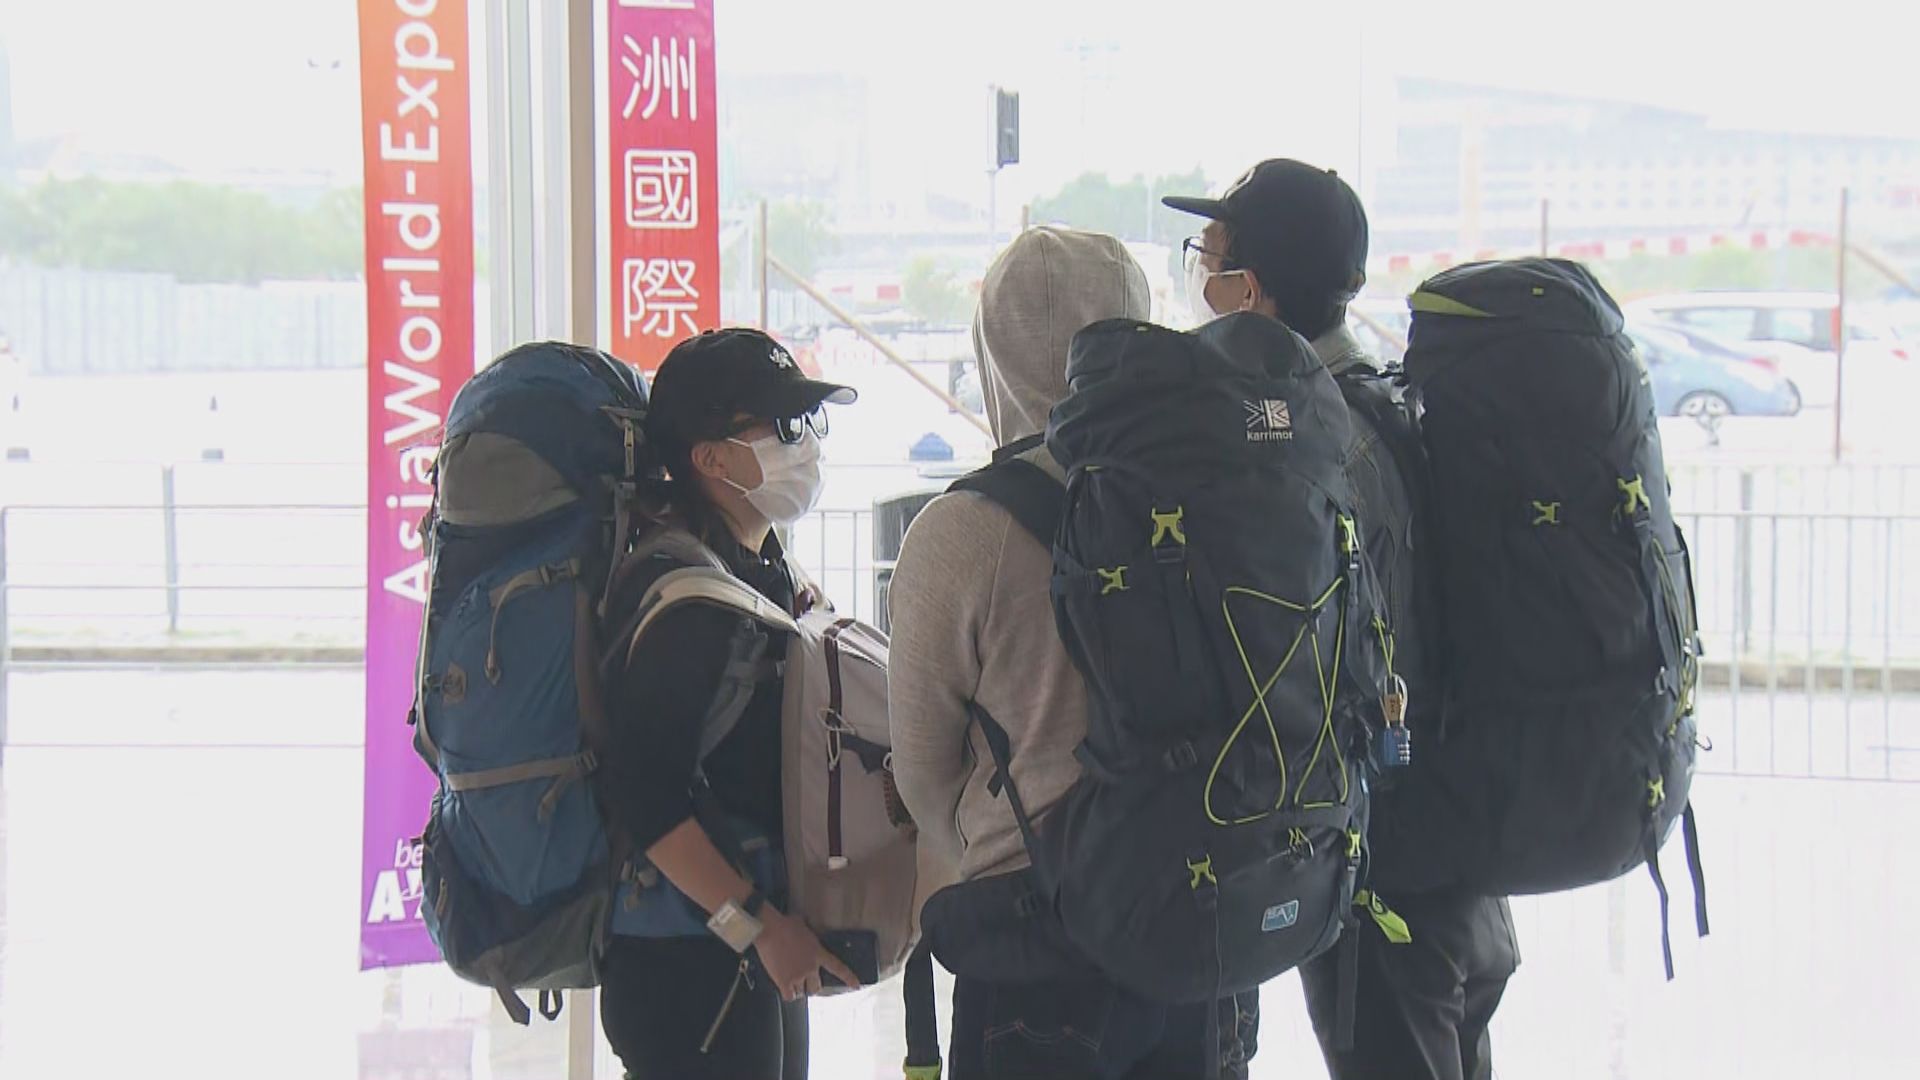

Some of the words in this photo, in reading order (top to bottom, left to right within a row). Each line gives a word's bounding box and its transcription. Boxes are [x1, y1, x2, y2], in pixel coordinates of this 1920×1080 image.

[619, 0, 699, 385] 洲國際
[1246, 430, 1293, 441] karrimor
